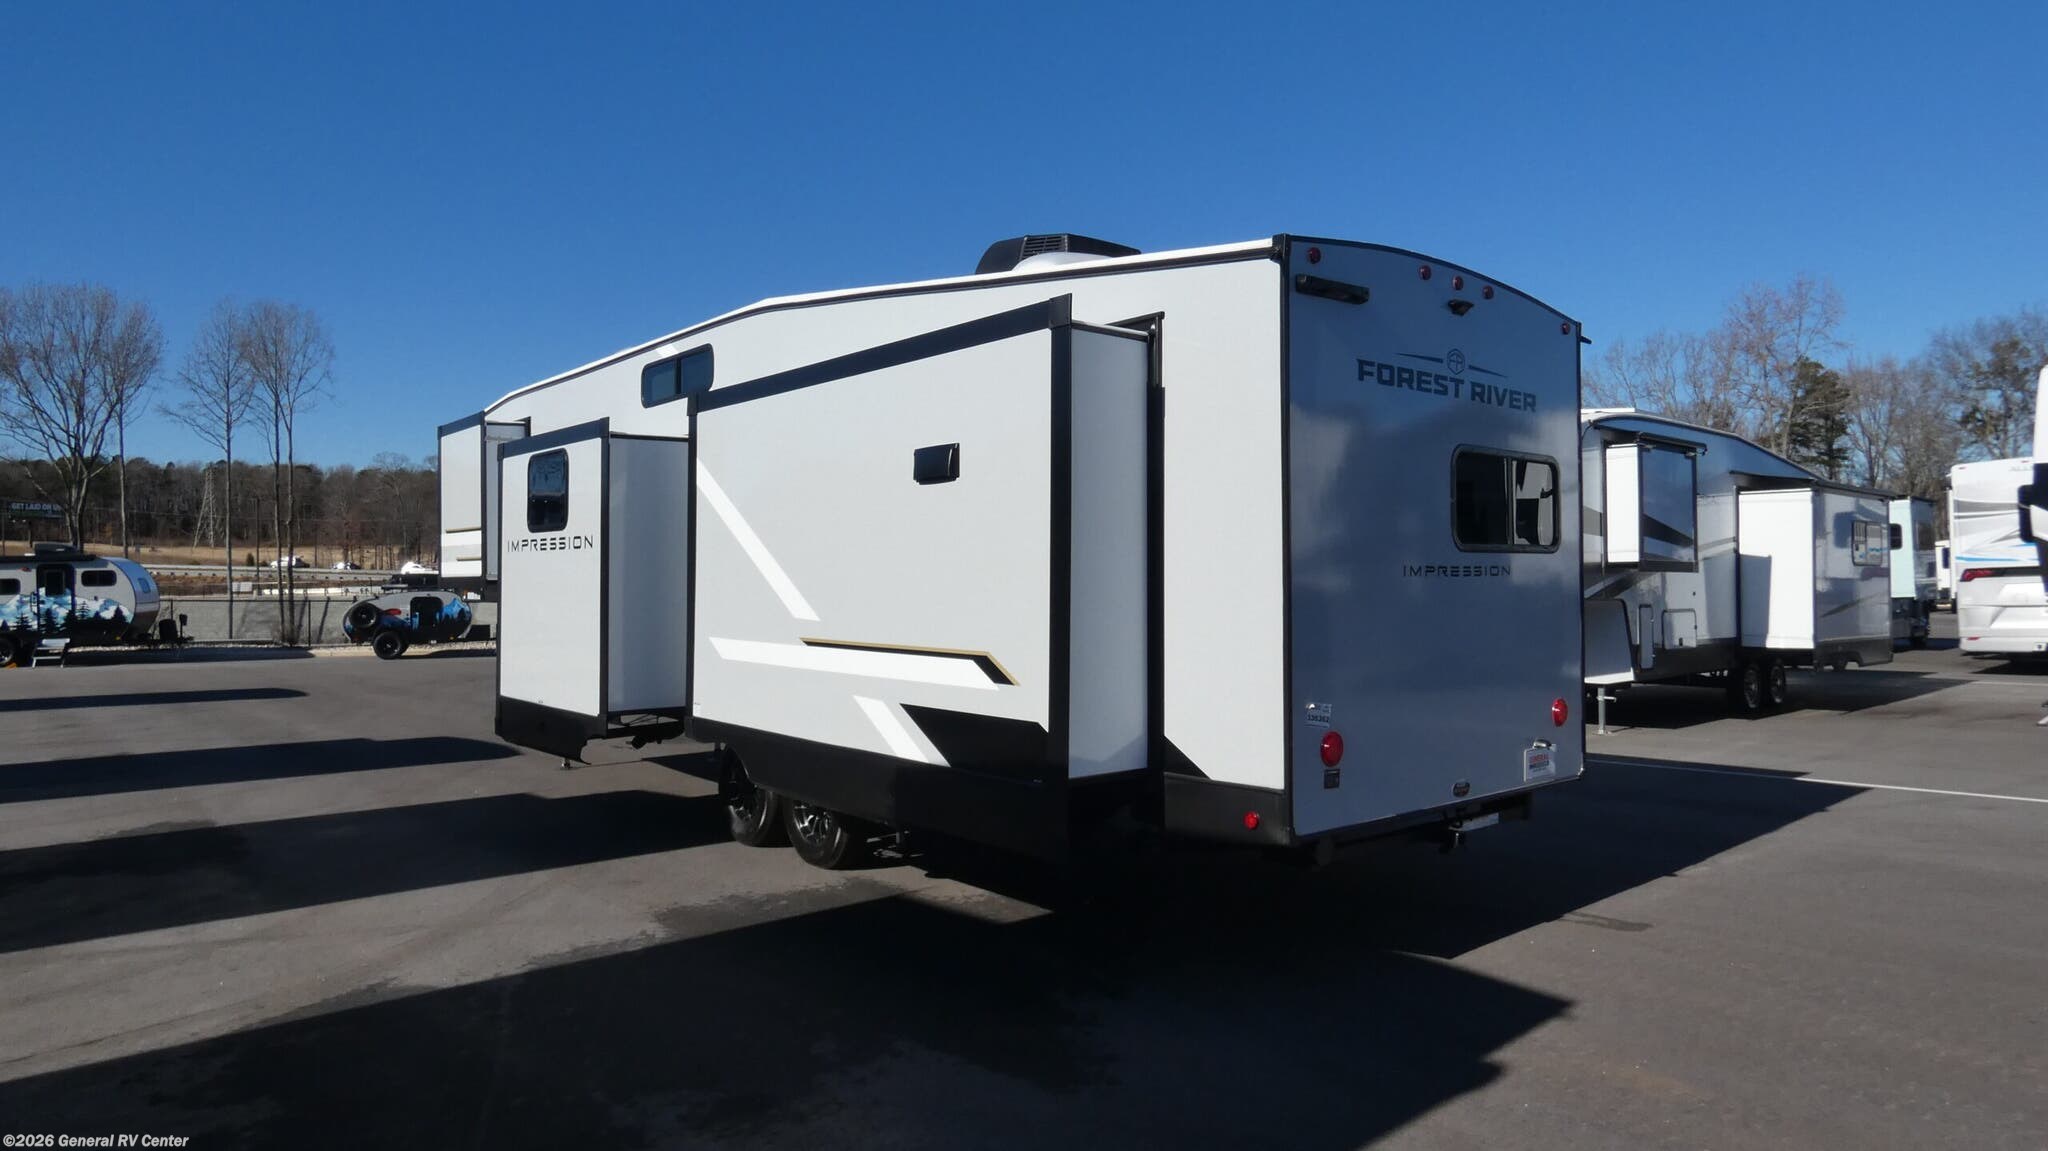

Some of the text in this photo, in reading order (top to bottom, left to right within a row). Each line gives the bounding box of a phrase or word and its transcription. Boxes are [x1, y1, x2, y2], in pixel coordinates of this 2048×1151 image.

[1356, 358, 1537, 413] FOREST RIVER
[11, 503, 25, 512] GET
[507, 535, 593, 552] IMPRESSION
[1403, 565, 1511, 577] IMPRESSION
